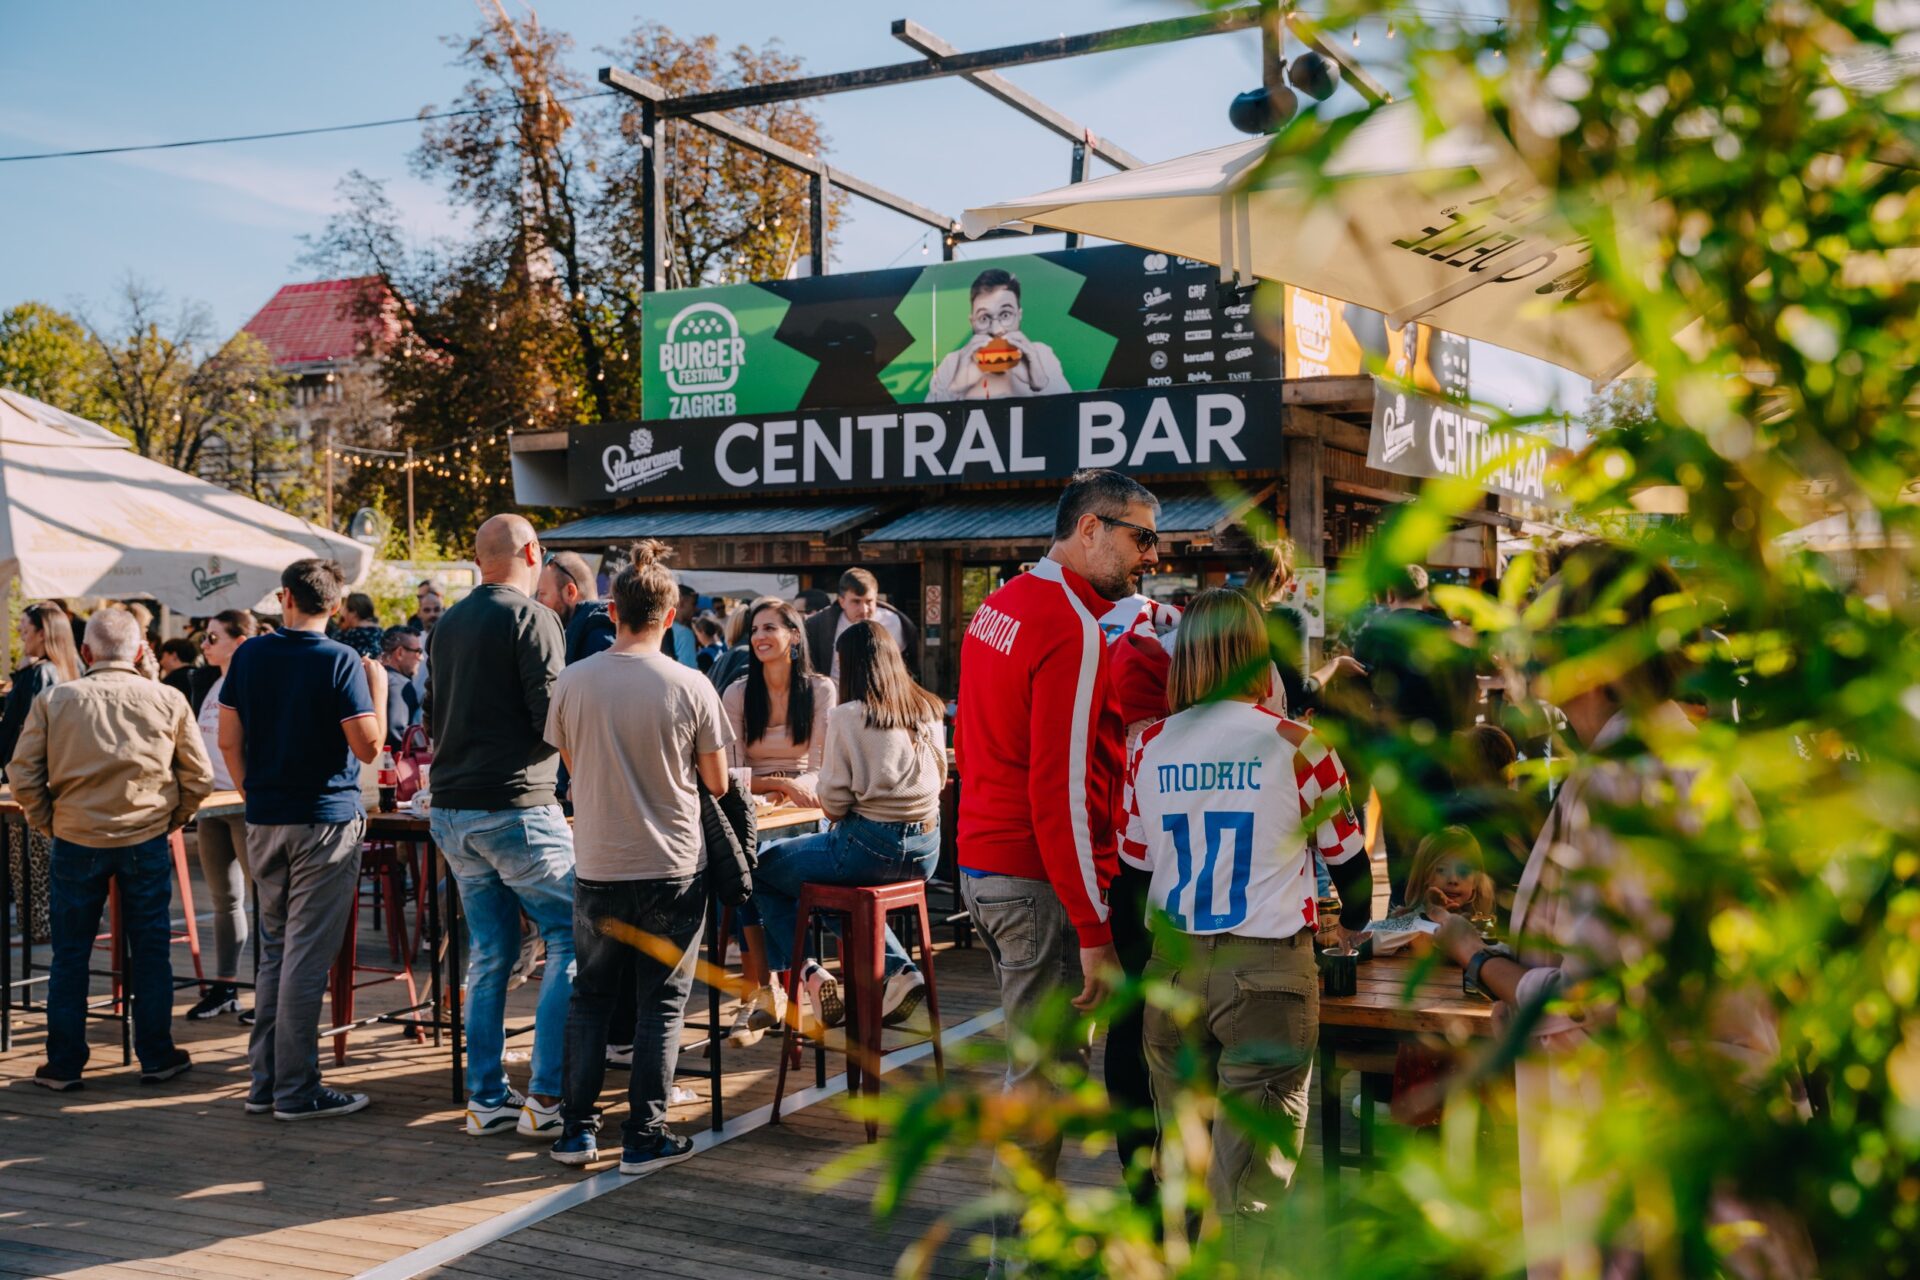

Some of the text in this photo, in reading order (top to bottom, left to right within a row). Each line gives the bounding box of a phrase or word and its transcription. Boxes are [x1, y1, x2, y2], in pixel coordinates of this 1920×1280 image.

[660, 337, 746, 372] BURGER
[679, 367, 726, 384] FESTIVAL
[669, 393, 737, 420] ZAGREB
[714, 393, 1247, 488] CENTRAL BAR
[602, 445, 684, 493] Staropramen
[968, 602, 1021, 656] CROATIA
[1157, 756, 1262, 793] MODRIĆ
[1161, 810, 1255, 932] 10
